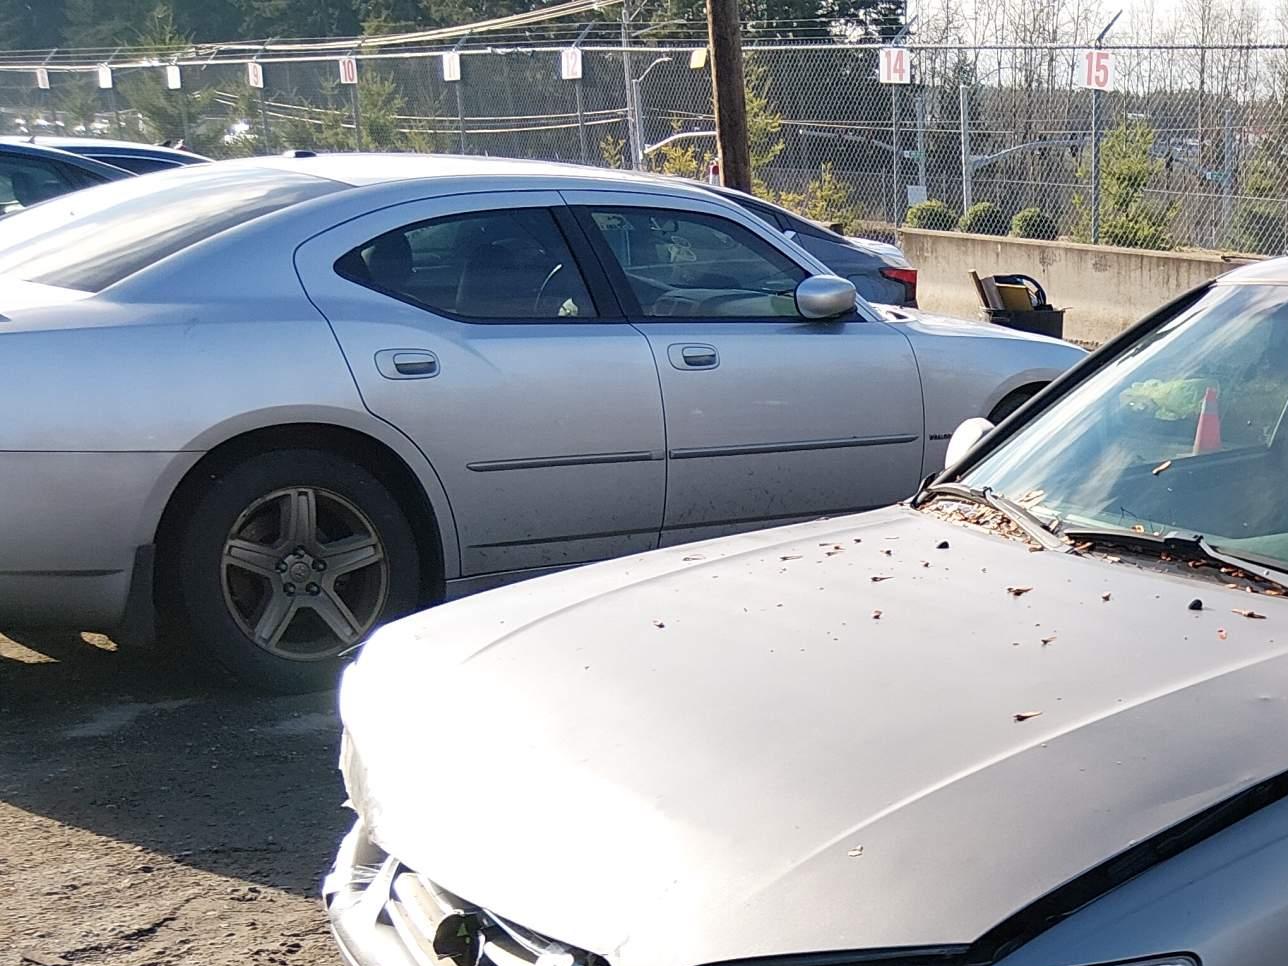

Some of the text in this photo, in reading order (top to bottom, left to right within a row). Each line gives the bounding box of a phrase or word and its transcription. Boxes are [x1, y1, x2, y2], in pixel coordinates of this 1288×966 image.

[252, 63, 260, 86] 9
[342, 60, 355, 82] 10
[565, 50, 579, 76] 12
[884, 49, 906, 81] 14
[1085, 51, 1109, 87] 15
